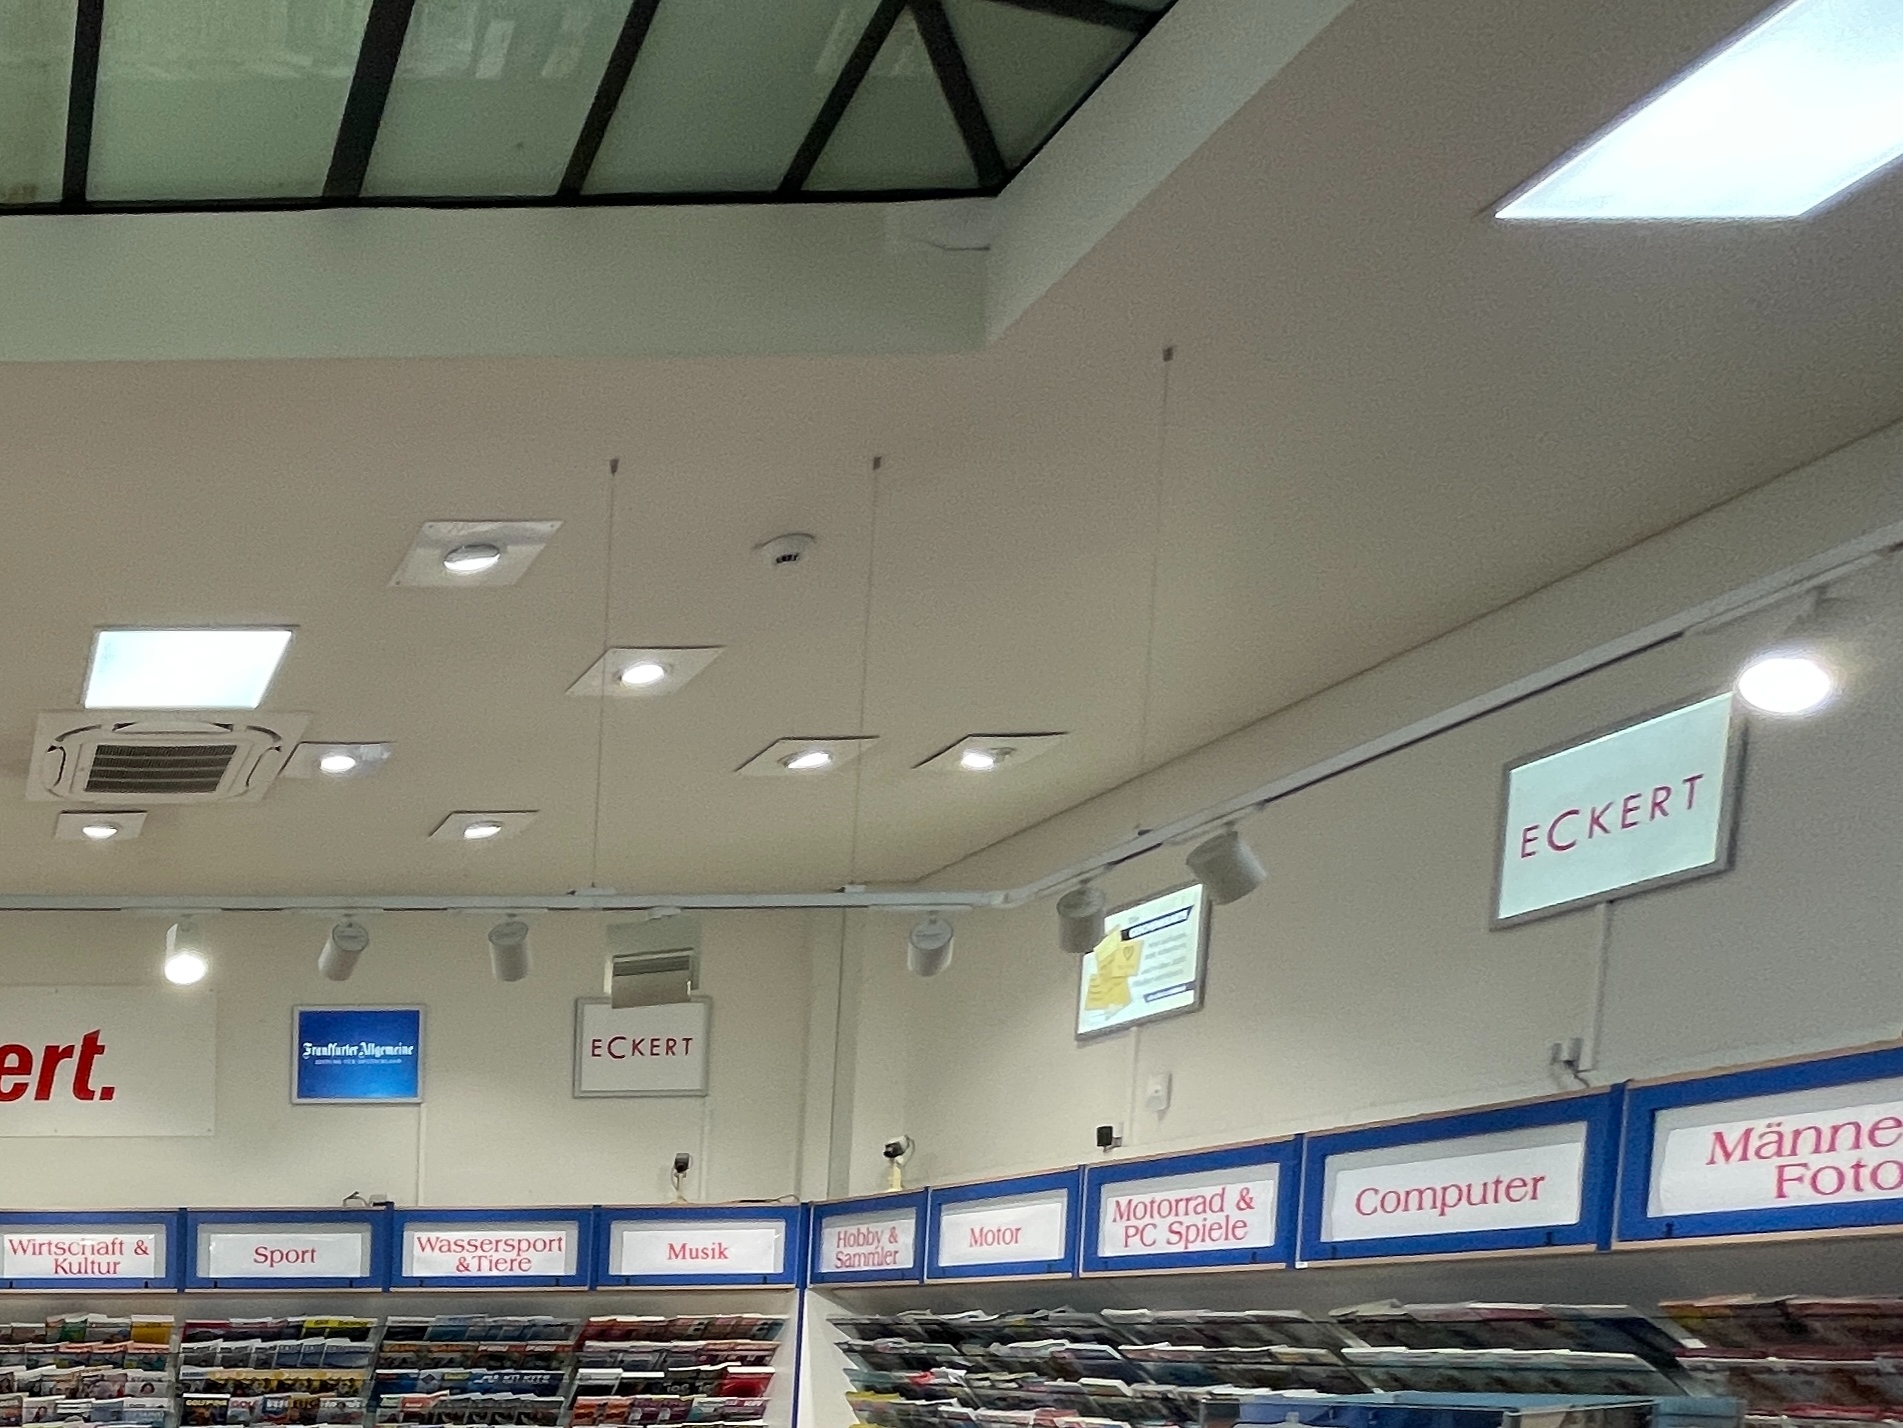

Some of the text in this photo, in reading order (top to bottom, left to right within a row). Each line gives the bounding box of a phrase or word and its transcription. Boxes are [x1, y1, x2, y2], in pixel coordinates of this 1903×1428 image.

[1520, 774, 1703, 858] ECKERT
[302, 1042, 414, 1059] Frankfurter Allgemeine
[591, 1035, 694, 1060] ECKERT
[1705, 1116, 1903, 1166] Männe
[1774, 1157, 1903, 1199] Foto
[1113, 1187, 1255, 1223] Motorrad &
[1354, 1174, 1546, 1221] Computer
[837, 1228, 898, 1248] Hobby &
[969, 1226, 1022, 1248] Motor
[1123, 1215, 1248, 1250] PC Spiele
[8, 1238, 151, 1259] Wirtschaft &
[253, 1244, 318, 1269] Sport
[416, 1235, 565, 1260] Wassersport
[666, 1243, 730, 1263] Musik
[834, 1248, 899, 1269] Sammler
[53, 1256, 121, 1276] Kultur
